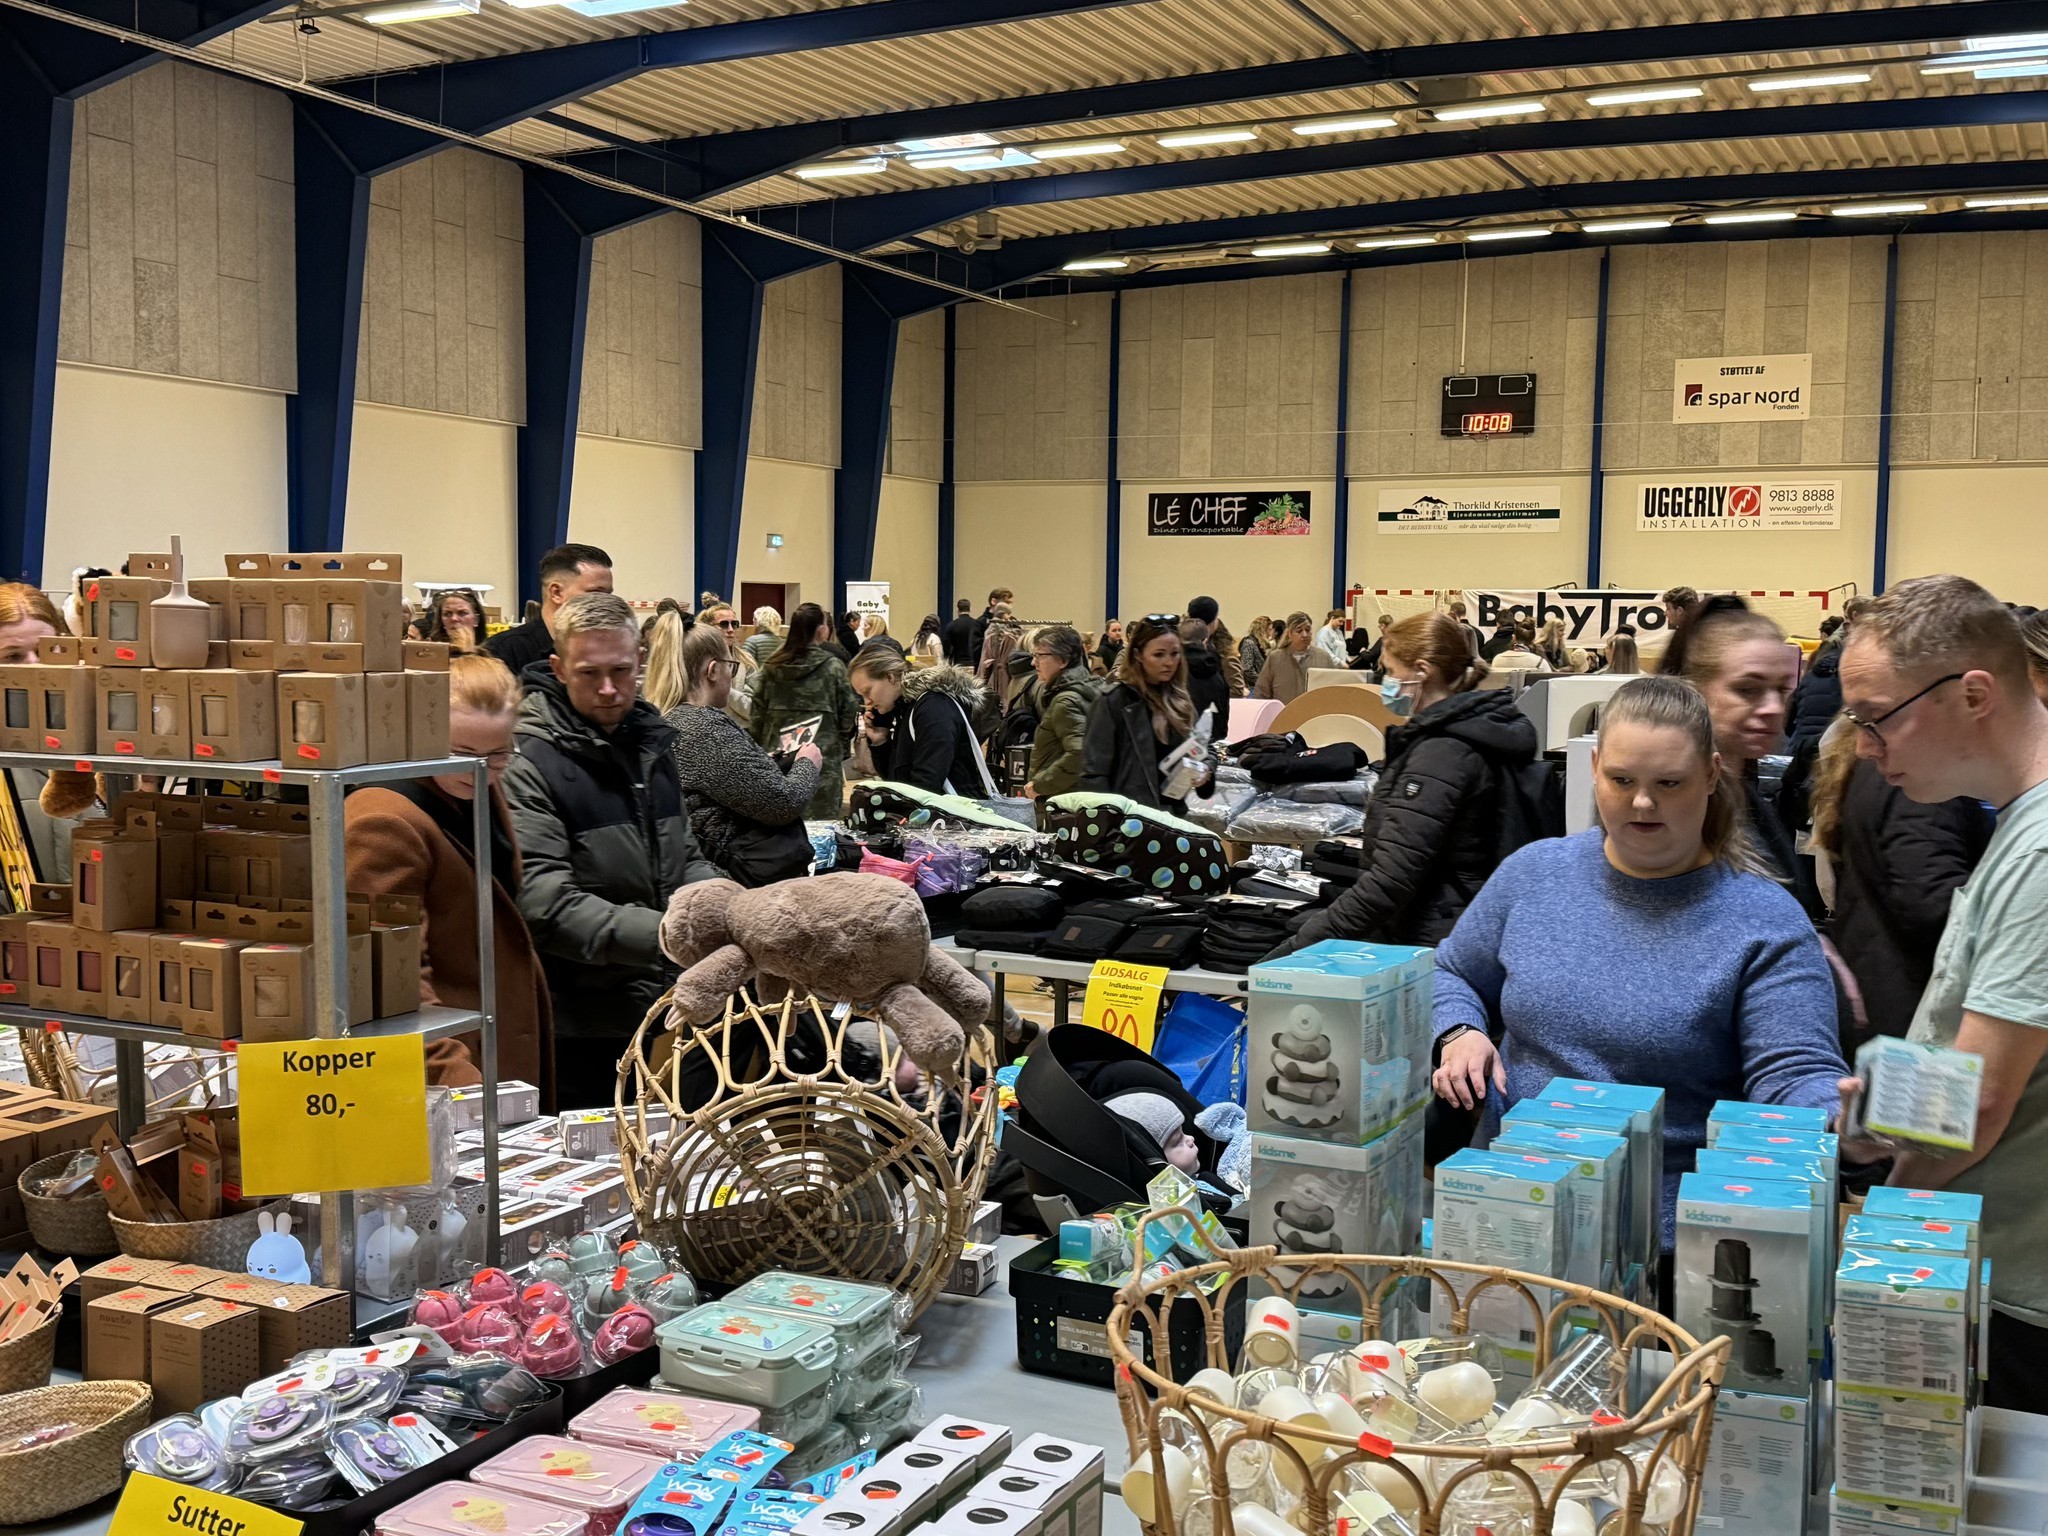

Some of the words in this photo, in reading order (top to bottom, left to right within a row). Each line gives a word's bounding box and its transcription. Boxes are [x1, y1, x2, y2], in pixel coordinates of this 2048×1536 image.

[1720, 366, 1754, 376] STØTTET
[1755, 365, 1766, 375] AF
[1468, 415, 1511, 431] 10:08
[1644, 486, 1727, 518] UGGERLY
[1769, 489, 1797, 502] 9813
[1802, 489, 1835, 501] 8888
[1190, 496, 1248, 525] CHEF
[1453, 501, 1491, 510] Thorkild
[1494, 500, 1540, 509] Kristensen
[1769, 503, 1834, 513] www.uggerly.dk
[1643, 518, 1761, 529] INSTALLATION
[1100, 966, 1149, 981] UDSALG
[1255, 977, 1293, 991] kidsme
[283, 1051, 376, 1076] Kopper
[306, 1093, 355, 1118] 80,-
[1258, 1144, 1296, 1160] kidsme
[1443, 1177, 1485, 1193] kidsme
[1685, 1208, 1733, 1225] kidsme
[167, 1495, 248, 1536] Sutter
